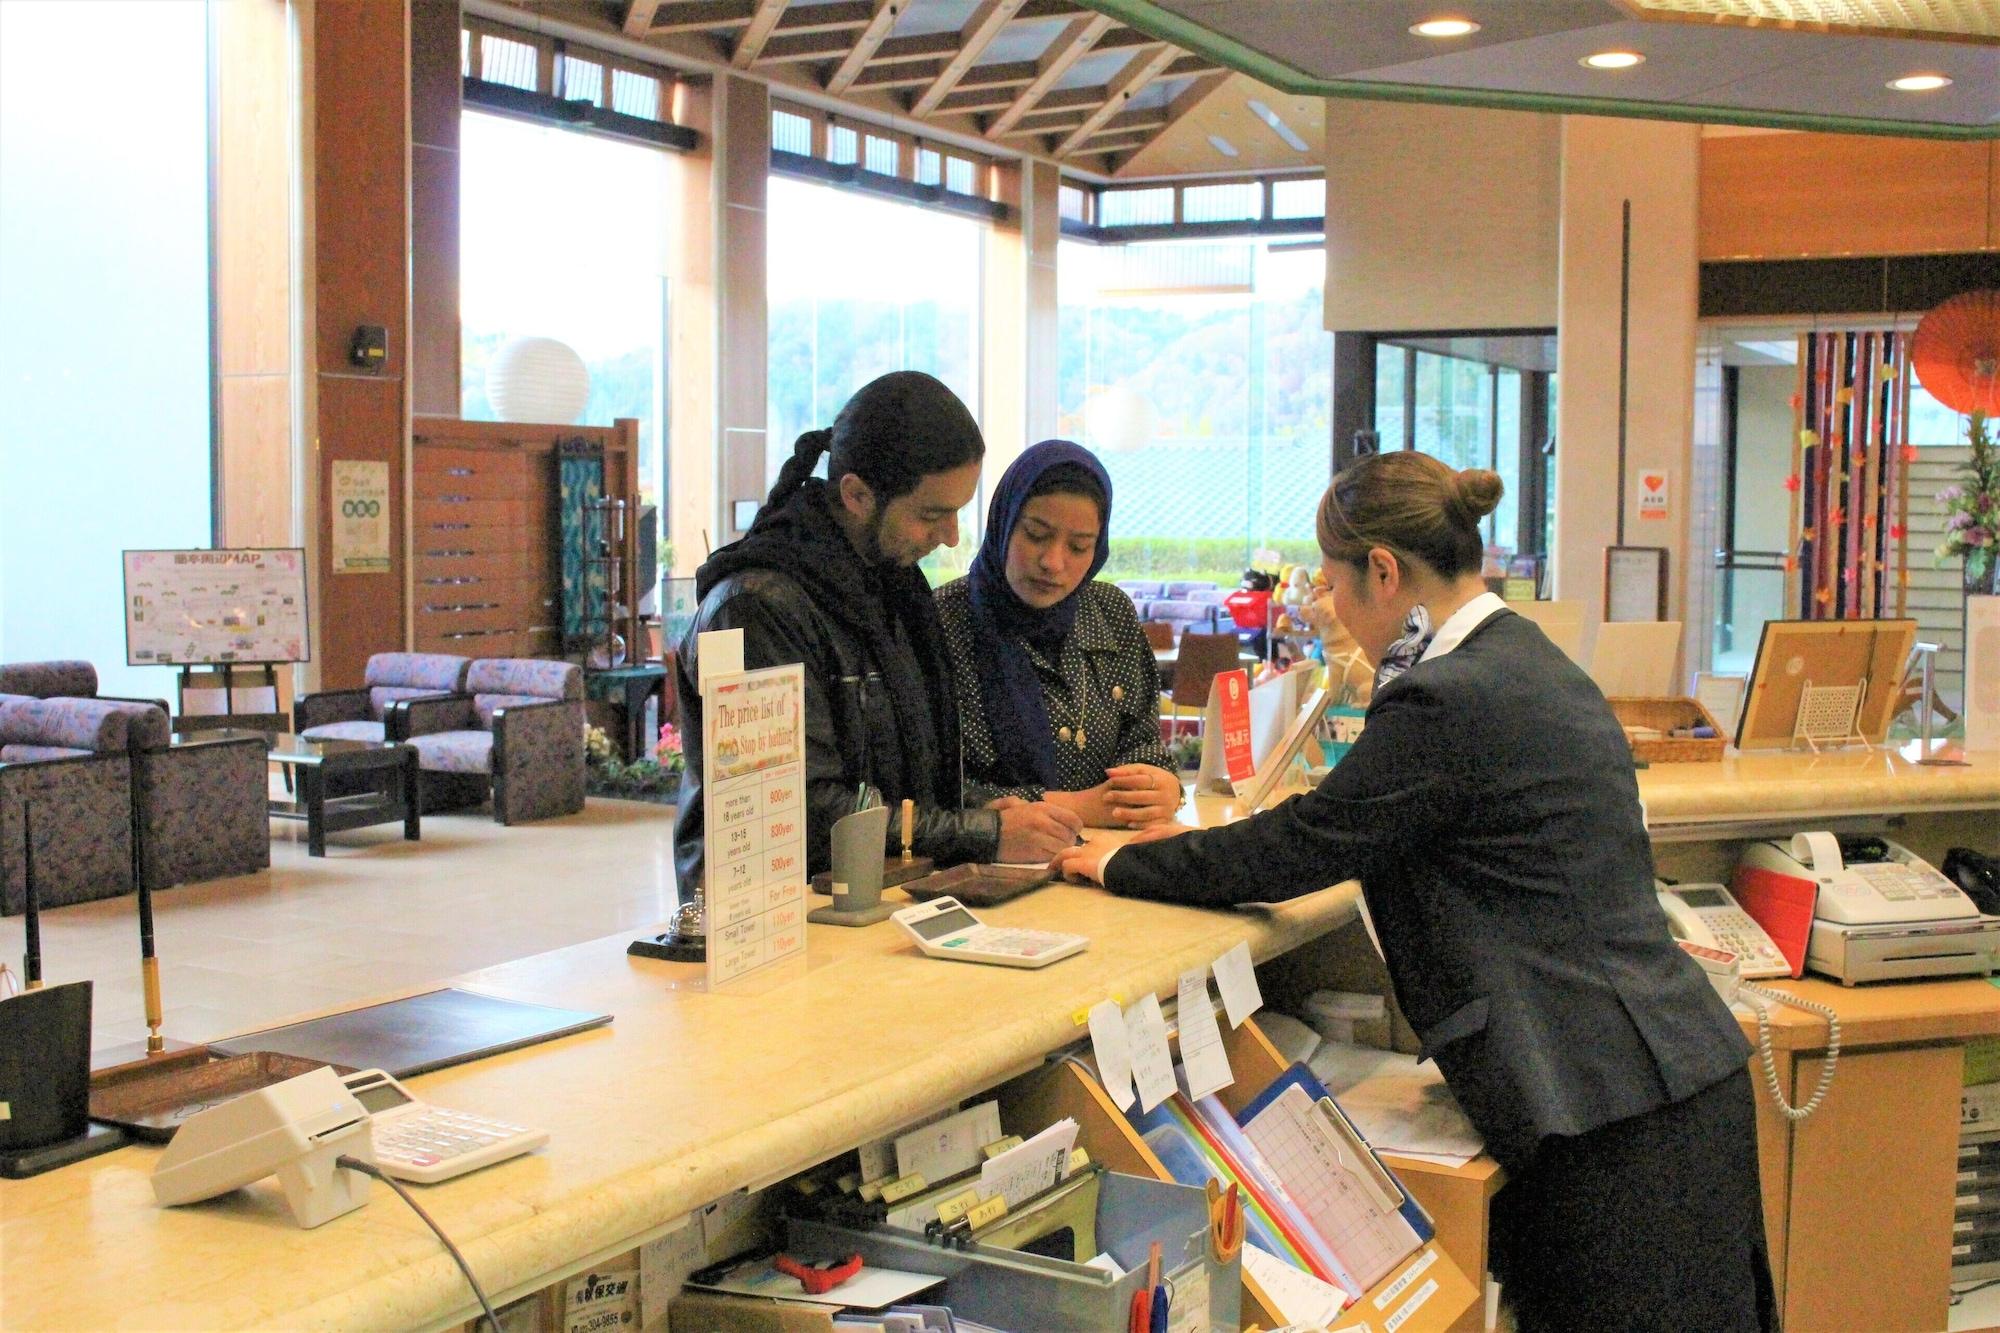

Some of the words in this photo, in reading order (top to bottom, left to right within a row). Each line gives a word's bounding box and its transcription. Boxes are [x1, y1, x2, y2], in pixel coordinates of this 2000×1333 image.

[1643, 496, 1664, 504] AED
[718, 704, 735, 728] The
[737, 700, 759, 728] price
[760, 695, 774, 720] list
[777, 694, 785, 716] of
[740, 735, 756, 756] Stop
[759, 732, 766, 752] by
[768, 727, 793, 748] bathing
[725, 798, 738, 808] more
[739, 795, 751, 804] than
[731, 809, 745, 822] years
[746, 806, 754, 815] old
[728, 846, 741, 859] years
[743, 841, 751, 852] old
[733, 863, 746, 877] 7-12
[729, 883, 741, 894] years
[783, 884, 796, 897] Free
[725, 928, 739, 941] Small
[741, 922, 755, 933] Towel
